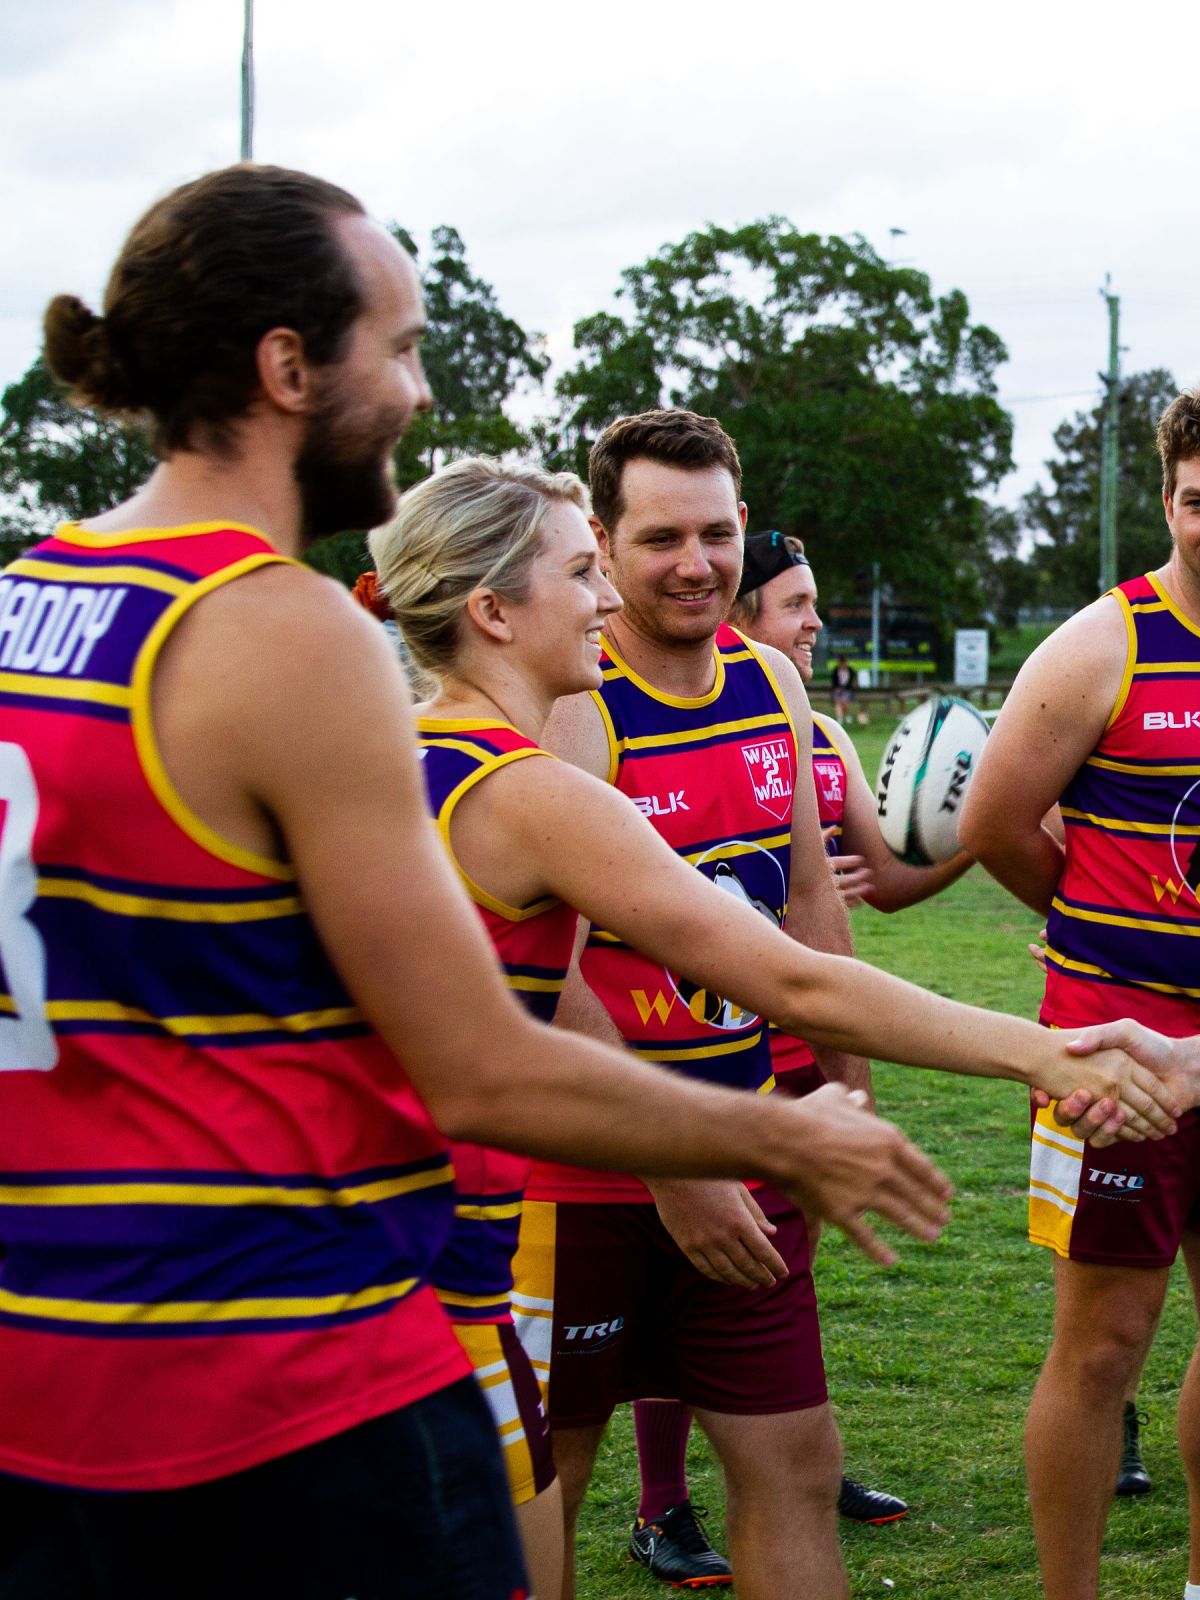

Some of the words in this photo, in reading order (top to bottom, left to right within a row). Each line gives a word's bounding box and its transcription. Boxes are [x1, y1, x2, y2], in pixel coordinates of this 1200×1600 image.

[0, 579, 128, 675] ADDY
[743, 743, 788, 765] WALL
[762, 758, 780, 786] 2
[829, 773, 839, 790] 2
[754, 779, 791, 802] WALL
[632, 790, 690, 817] BLK
[1089, 1168, 1144, 1189] TRL
[564, 1317, 624, 1340] TRL
